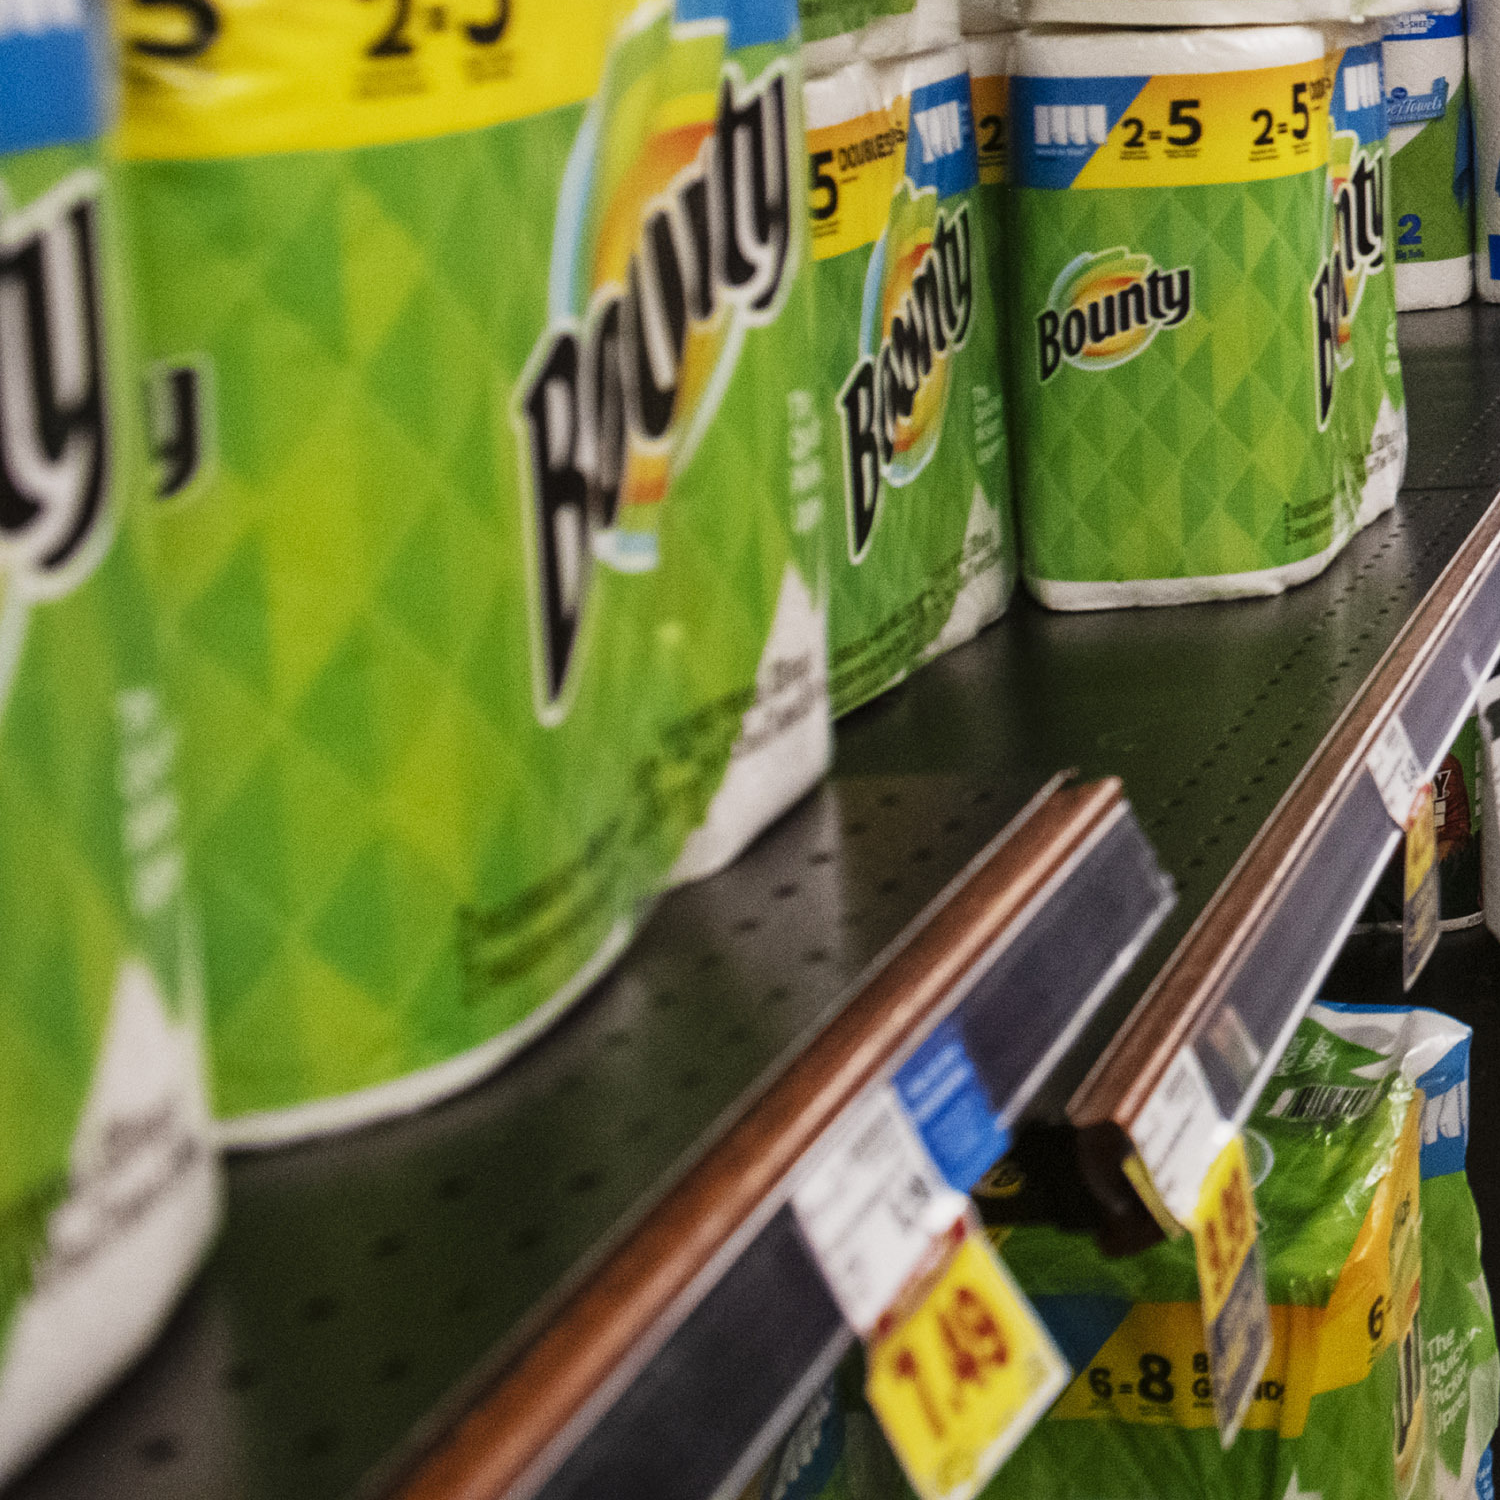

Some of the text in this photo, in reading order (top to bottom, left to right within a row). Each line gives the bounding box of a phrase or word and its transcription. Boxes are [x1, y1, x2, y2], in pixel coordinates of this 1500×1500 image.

[1397, 213, 1423, 245] 2
[843, 203, 972, 558] Bounty
[1036, 270, 1191, 382] Bounty
